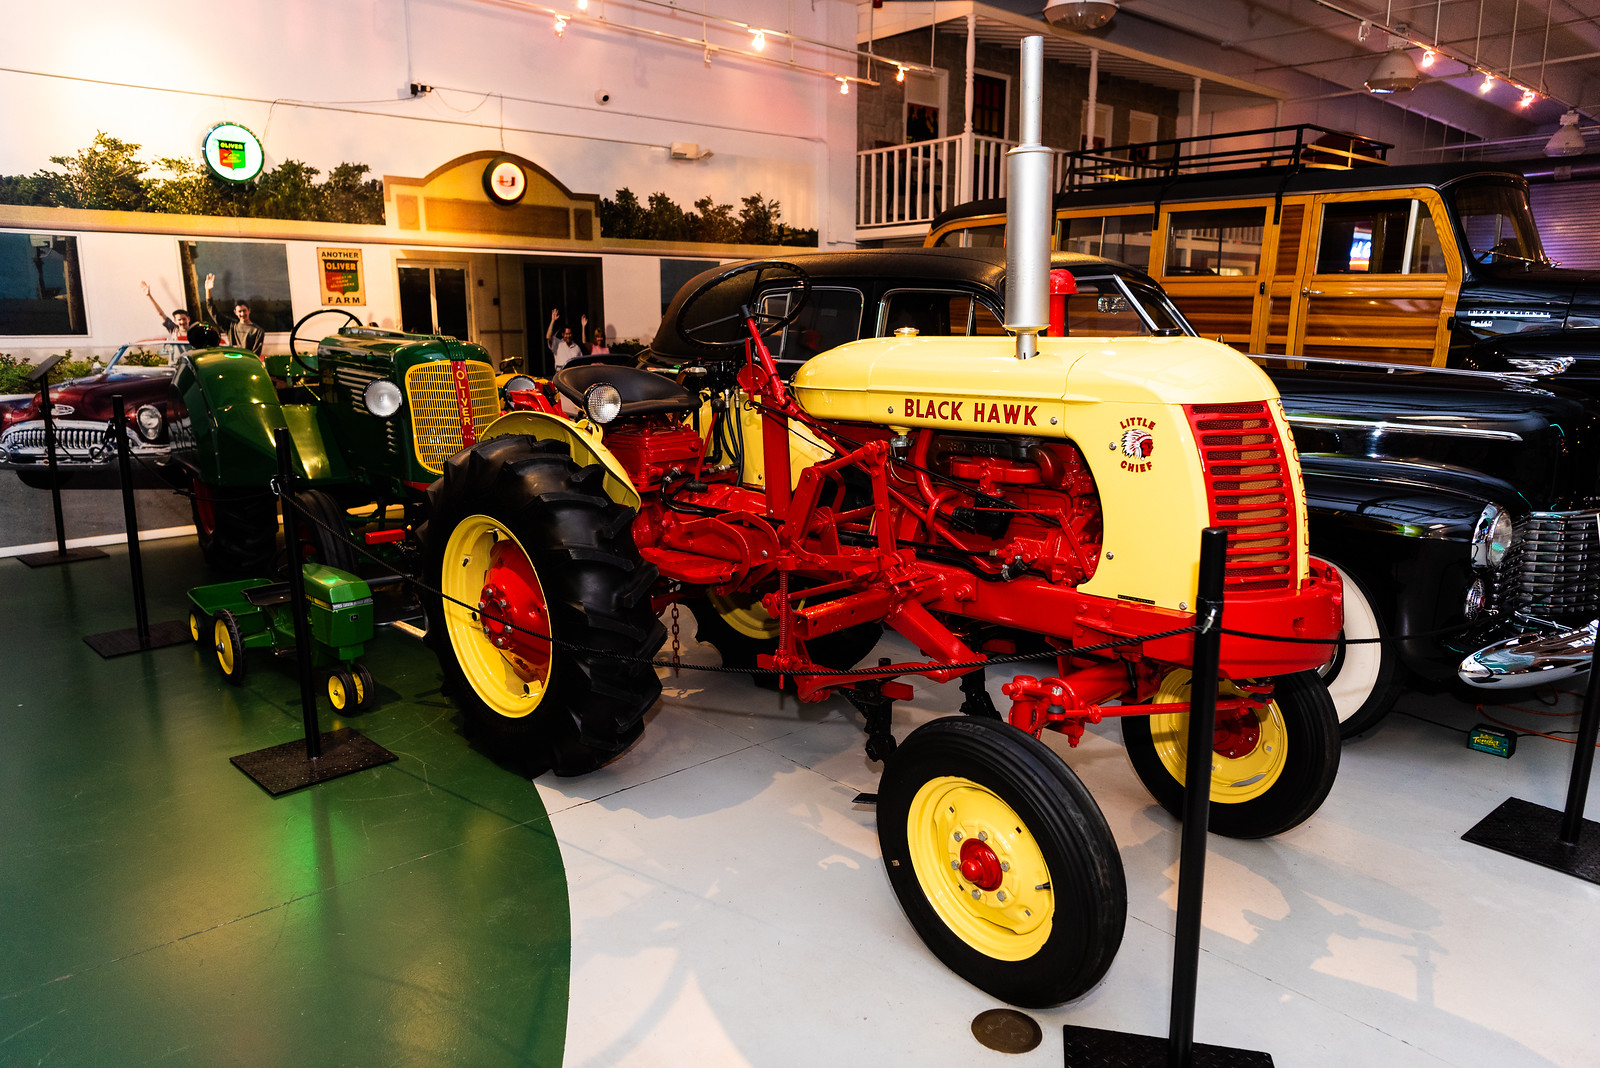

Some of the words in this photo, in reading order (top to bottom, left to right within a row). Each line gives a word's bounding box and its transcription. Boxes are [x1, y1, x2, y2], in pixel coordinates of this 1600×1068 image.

[220, 142, 244, 150] OLIVER
[325, 262, 357, 270] OLIVER
[327, 296, 361, 304] FARM
[1467, 310, 1551, 318] INTERNATIONAL
[456, 370, 472, 426] OLIVER
[904, 398, 964, 421] BLACK
[973, 402, 1038, 426] HAWK
[1119, 416, 1157, 431] LITTLE
[1120, 460, 1153, 473] CHIEF
